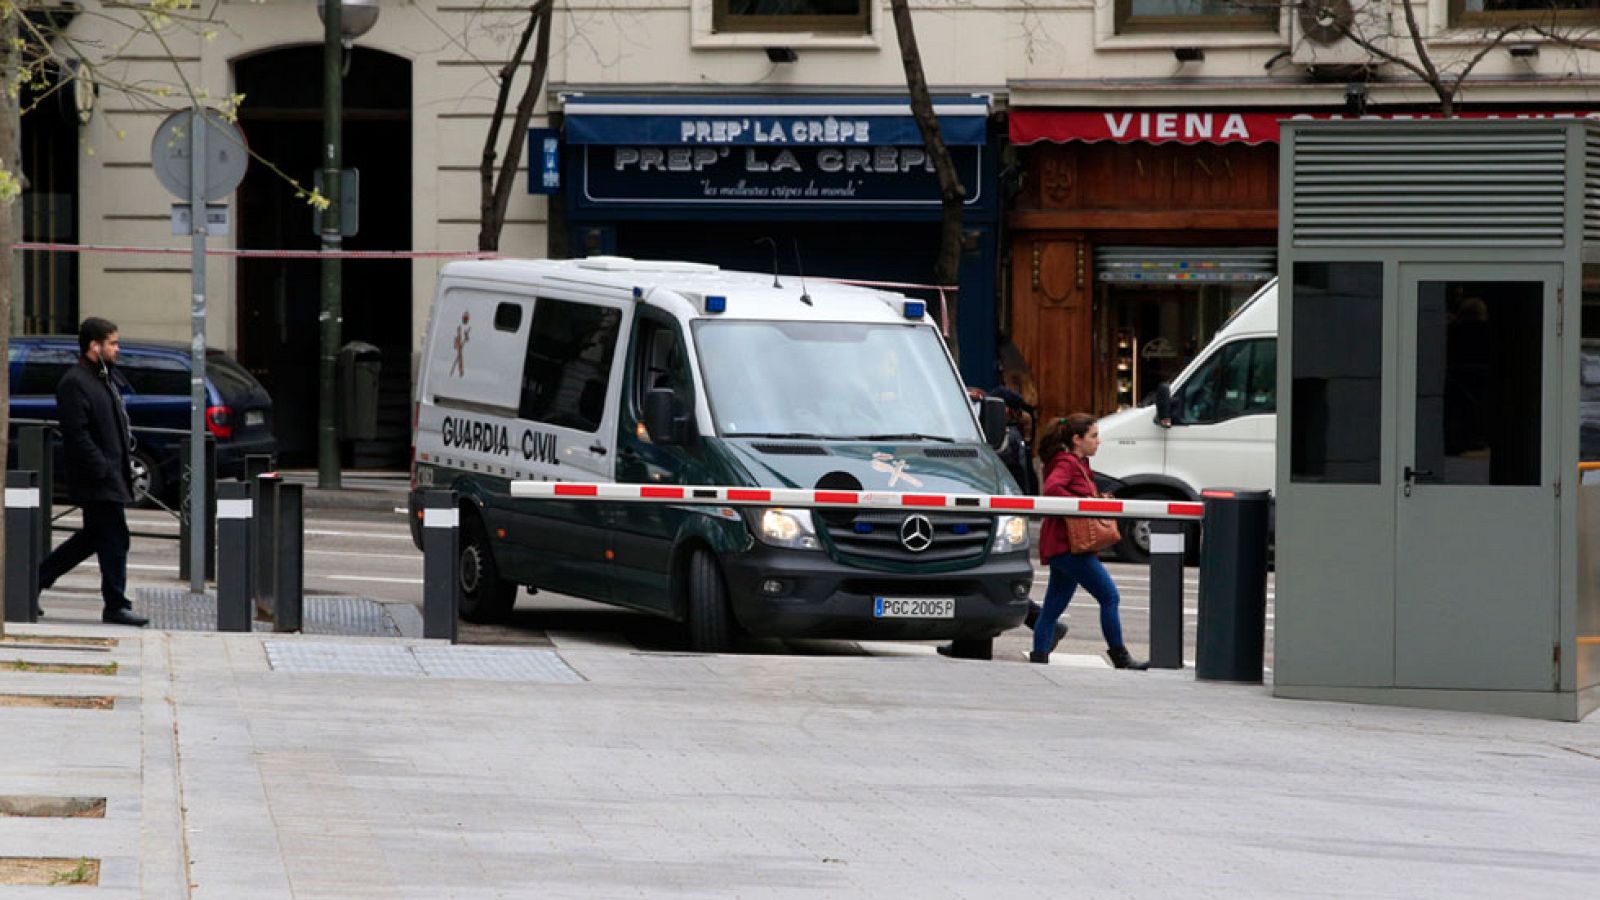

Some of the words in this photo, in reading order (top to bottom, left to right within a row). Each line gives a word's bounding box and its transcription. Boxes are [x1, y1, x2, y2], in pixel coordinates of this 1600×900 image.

[754, 121, 788, 142] LA
[791, 116, 869, 142] CRÊPE
[1104, 113, 1249, 138] VIENA
[745, 147, 802, 171] LA
[804, 179, 819, 196] du
[442, 415, 509, 456] GUARDIA
[521, 428, 561, 465] CIVIL
